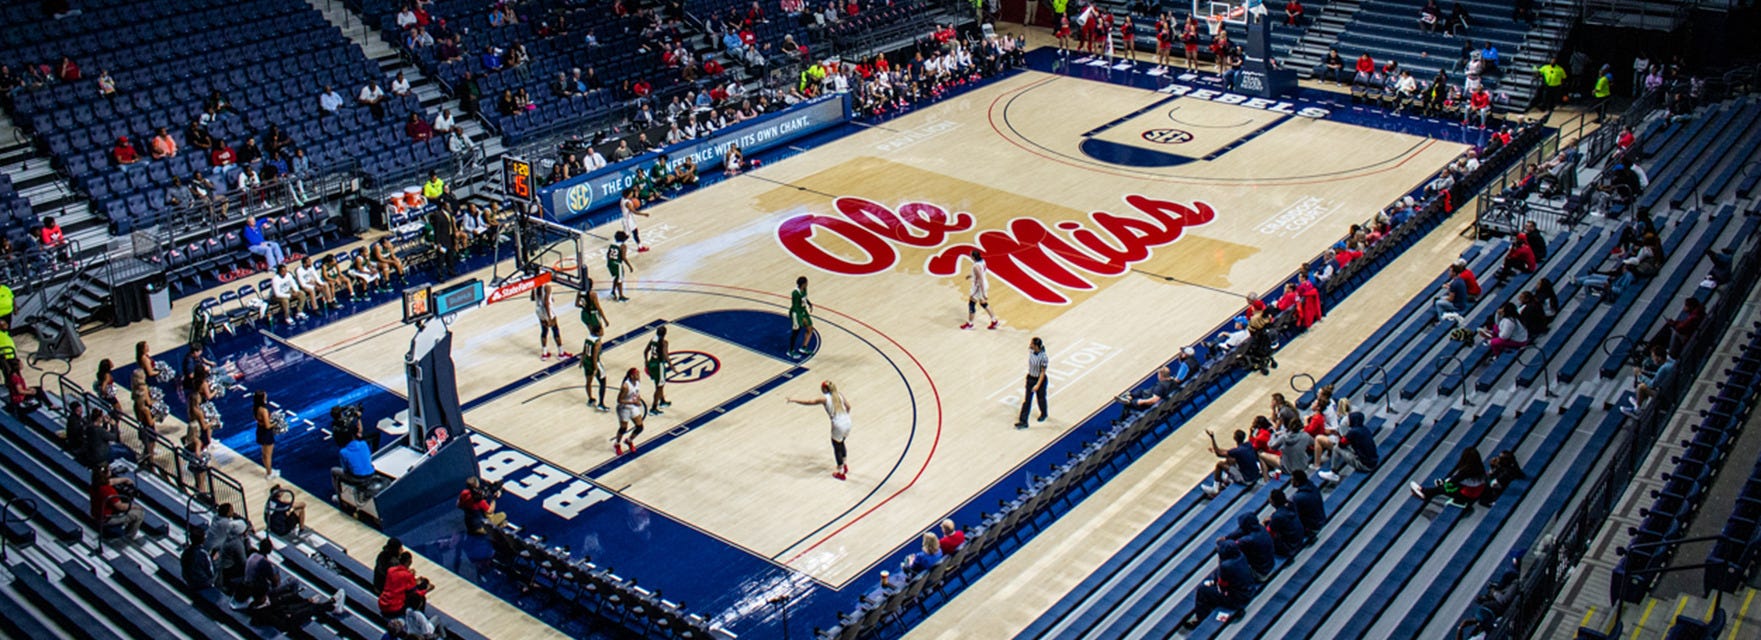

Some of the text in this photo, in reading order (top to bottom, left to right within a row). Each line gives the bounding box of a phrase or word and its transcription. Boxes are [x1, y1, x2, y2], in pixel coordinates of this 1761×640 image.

[1158, 83, 1329, 117] REBELS
[601, 179, 622, 196] THE
[625, 168, 650, 187] OY
[740, 133, 755, 150] ITS
[757, 125, 778, 142] OWN
[780, 115, 809, 134] CHANT.
[568, 184, 591, 212] SEC
[777, 196, 974, 275] Ole
[926, 194, 1216, 304] Miss
